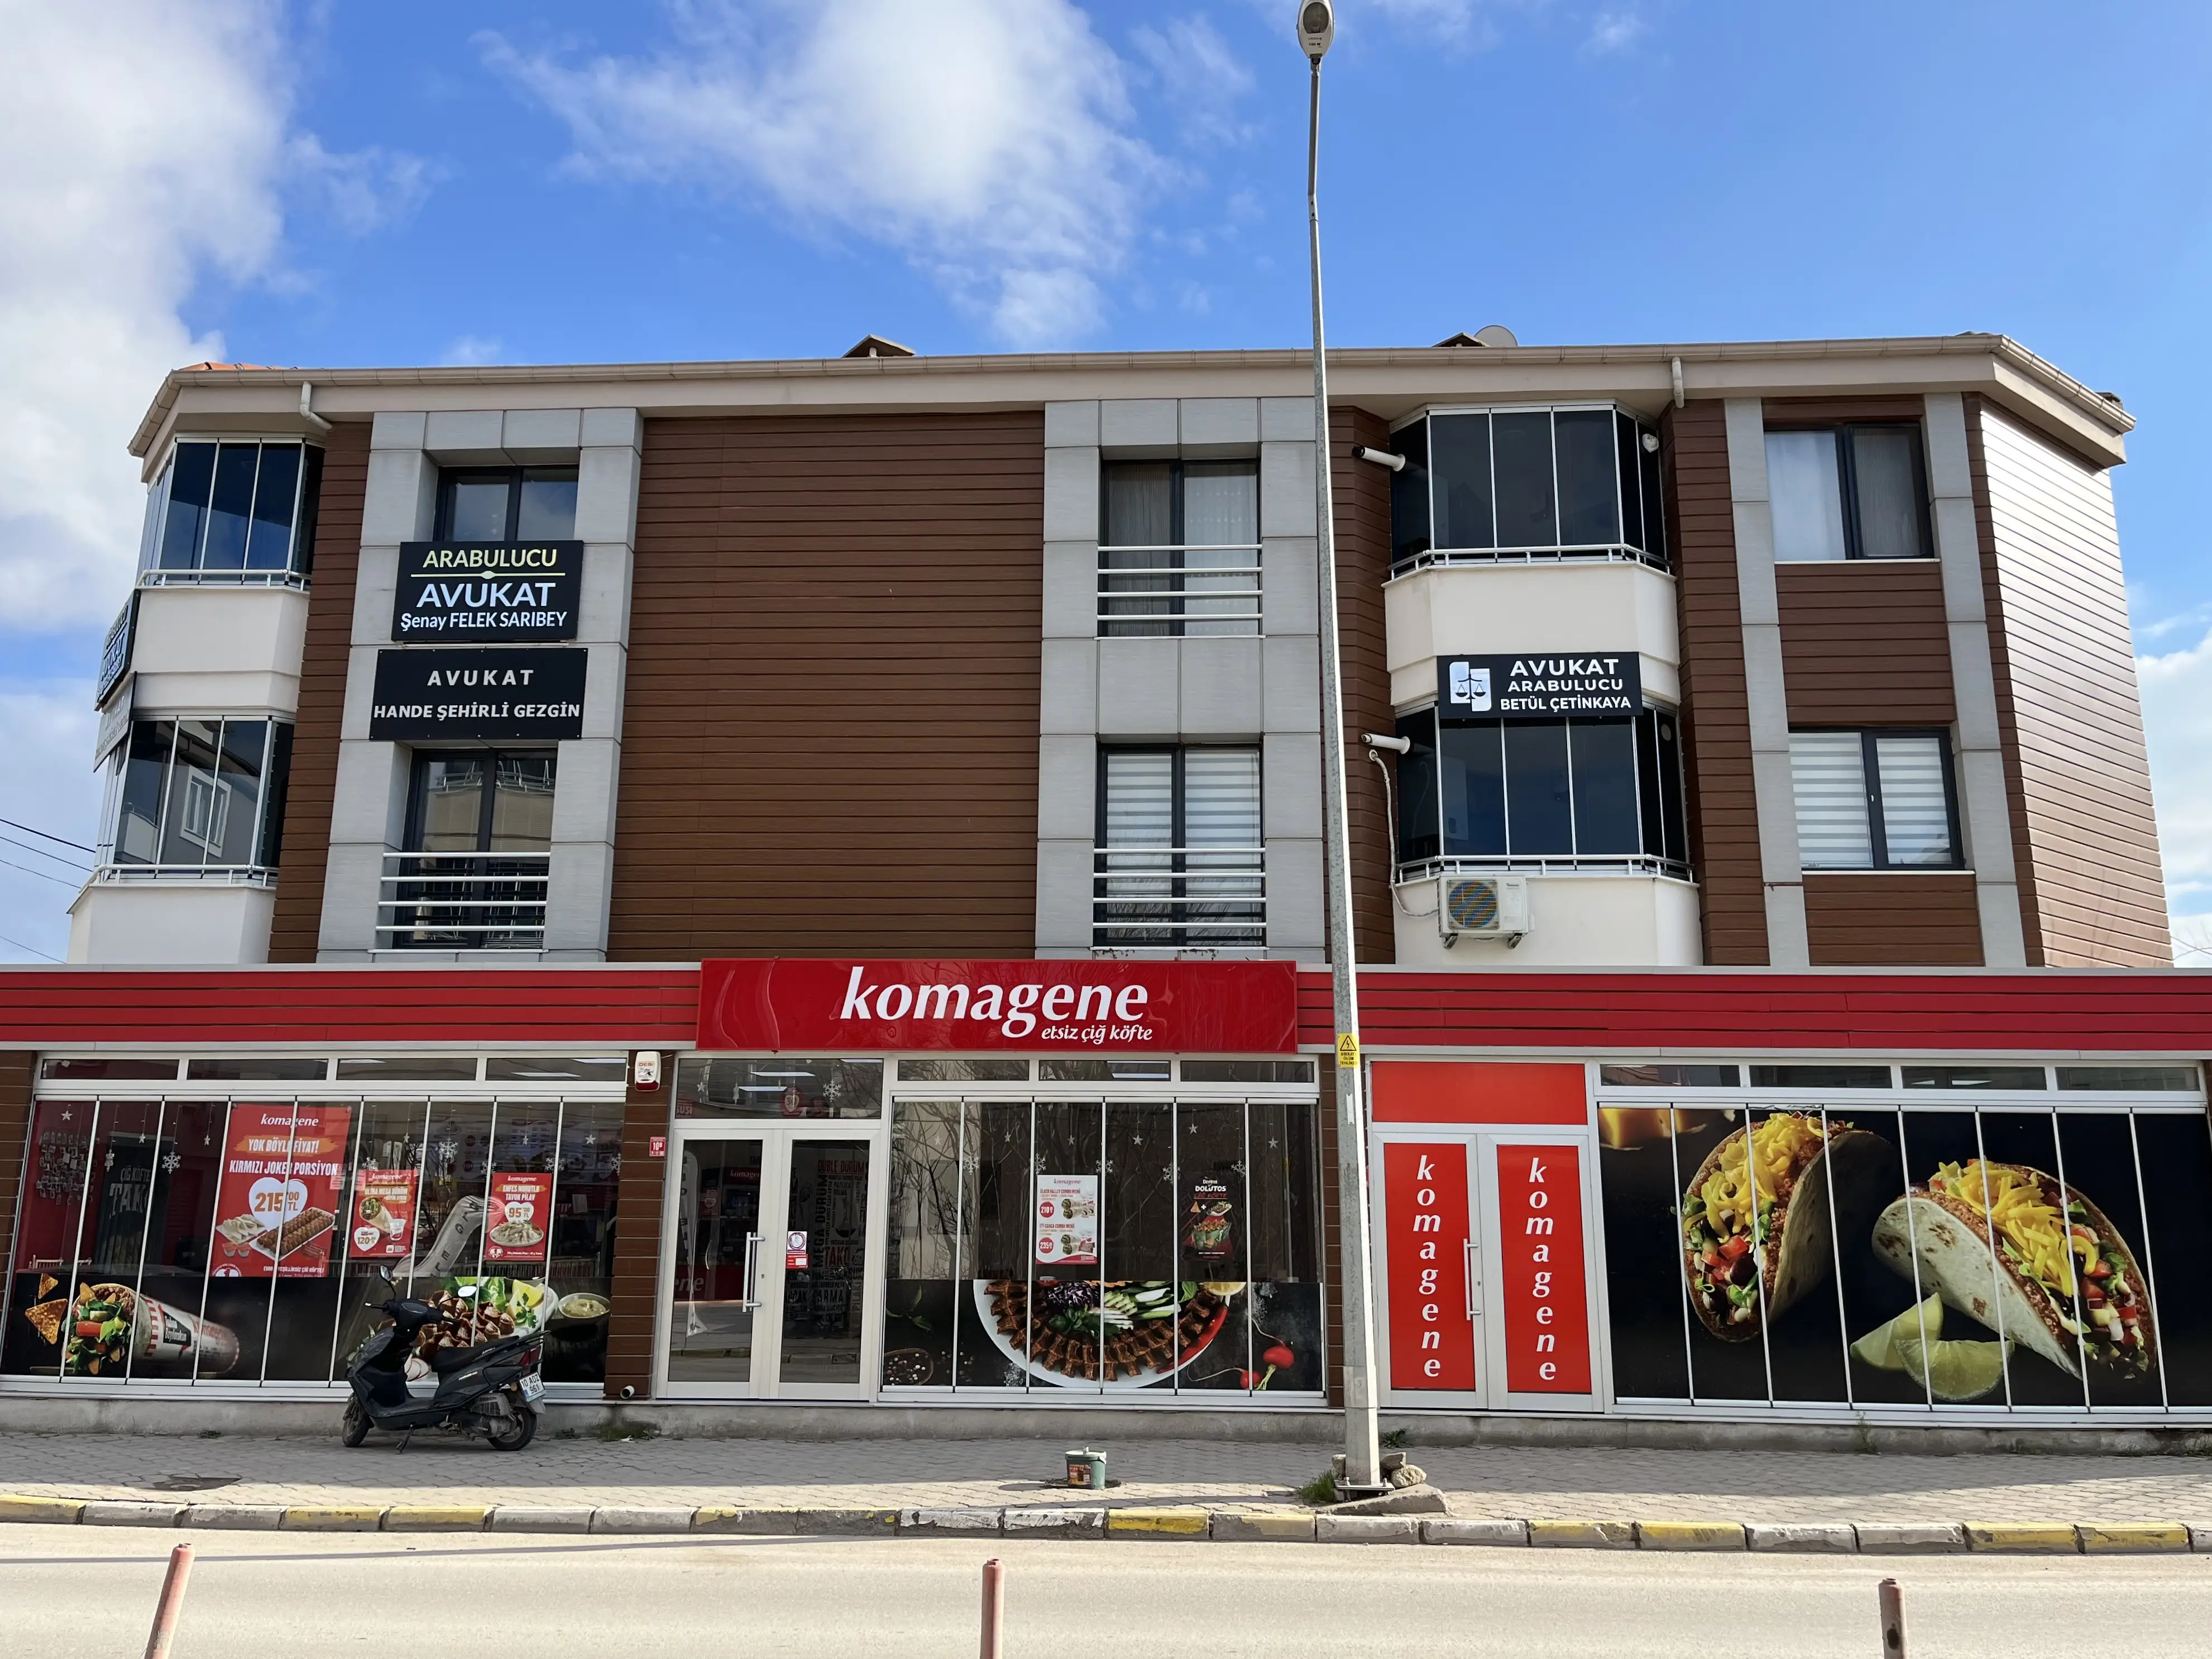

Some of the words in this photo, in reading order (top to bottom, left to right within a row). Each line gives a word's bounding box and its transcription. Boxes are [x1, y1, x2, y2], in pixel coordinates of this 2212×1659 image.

[423, 549, 557, 568] ARABULUCU
[416, 582, 556, 608] AVUKAT
[400, 613, 447, 632] Şenay
[449, 612, 496, 628] FELEK
[499, 611, 567, 627] SARIBEY
[1510, 658, 1619, 677] AVUKAT
[427, 670, 534, 686] AVUKAT
[1507, 679, 1623, 692] ARABULUCU
[374, 705, 433, 718] HANDE
[437, 701, 509, 721] ŞEHİRLİ
[514, 701, 580, 718] GEZGİN
[1500, 695, 1547, 711] BETÜL
[1550, 694, 1631, 713] ÇETİNKAYA
[840, 965, 1148, 1039] komagene
[1041, 1024, 1079, 1040] etsiz
[1081, 1024, 1107, 1045] çiğ
[1109, 1024, 1153, 1043] köfte
[248, 1139, 266, 1152] YOK
[266, 1137, 291, 1153] BÖYL
[293, 1137, 320, 1153] FİYAT!
[229, 1160, 264, 1173] KIRMIZI
[293, 1160, 338, 1176] PORSİYON
[288, 1202, 298, 1211] TL
[509, 1207, 522, 1218] 95
[1413, 1155, 1441, 1378] komagene
[1525, 1157, 1557, 1381] komagene
[521, 1379, 528, 1388] 10
